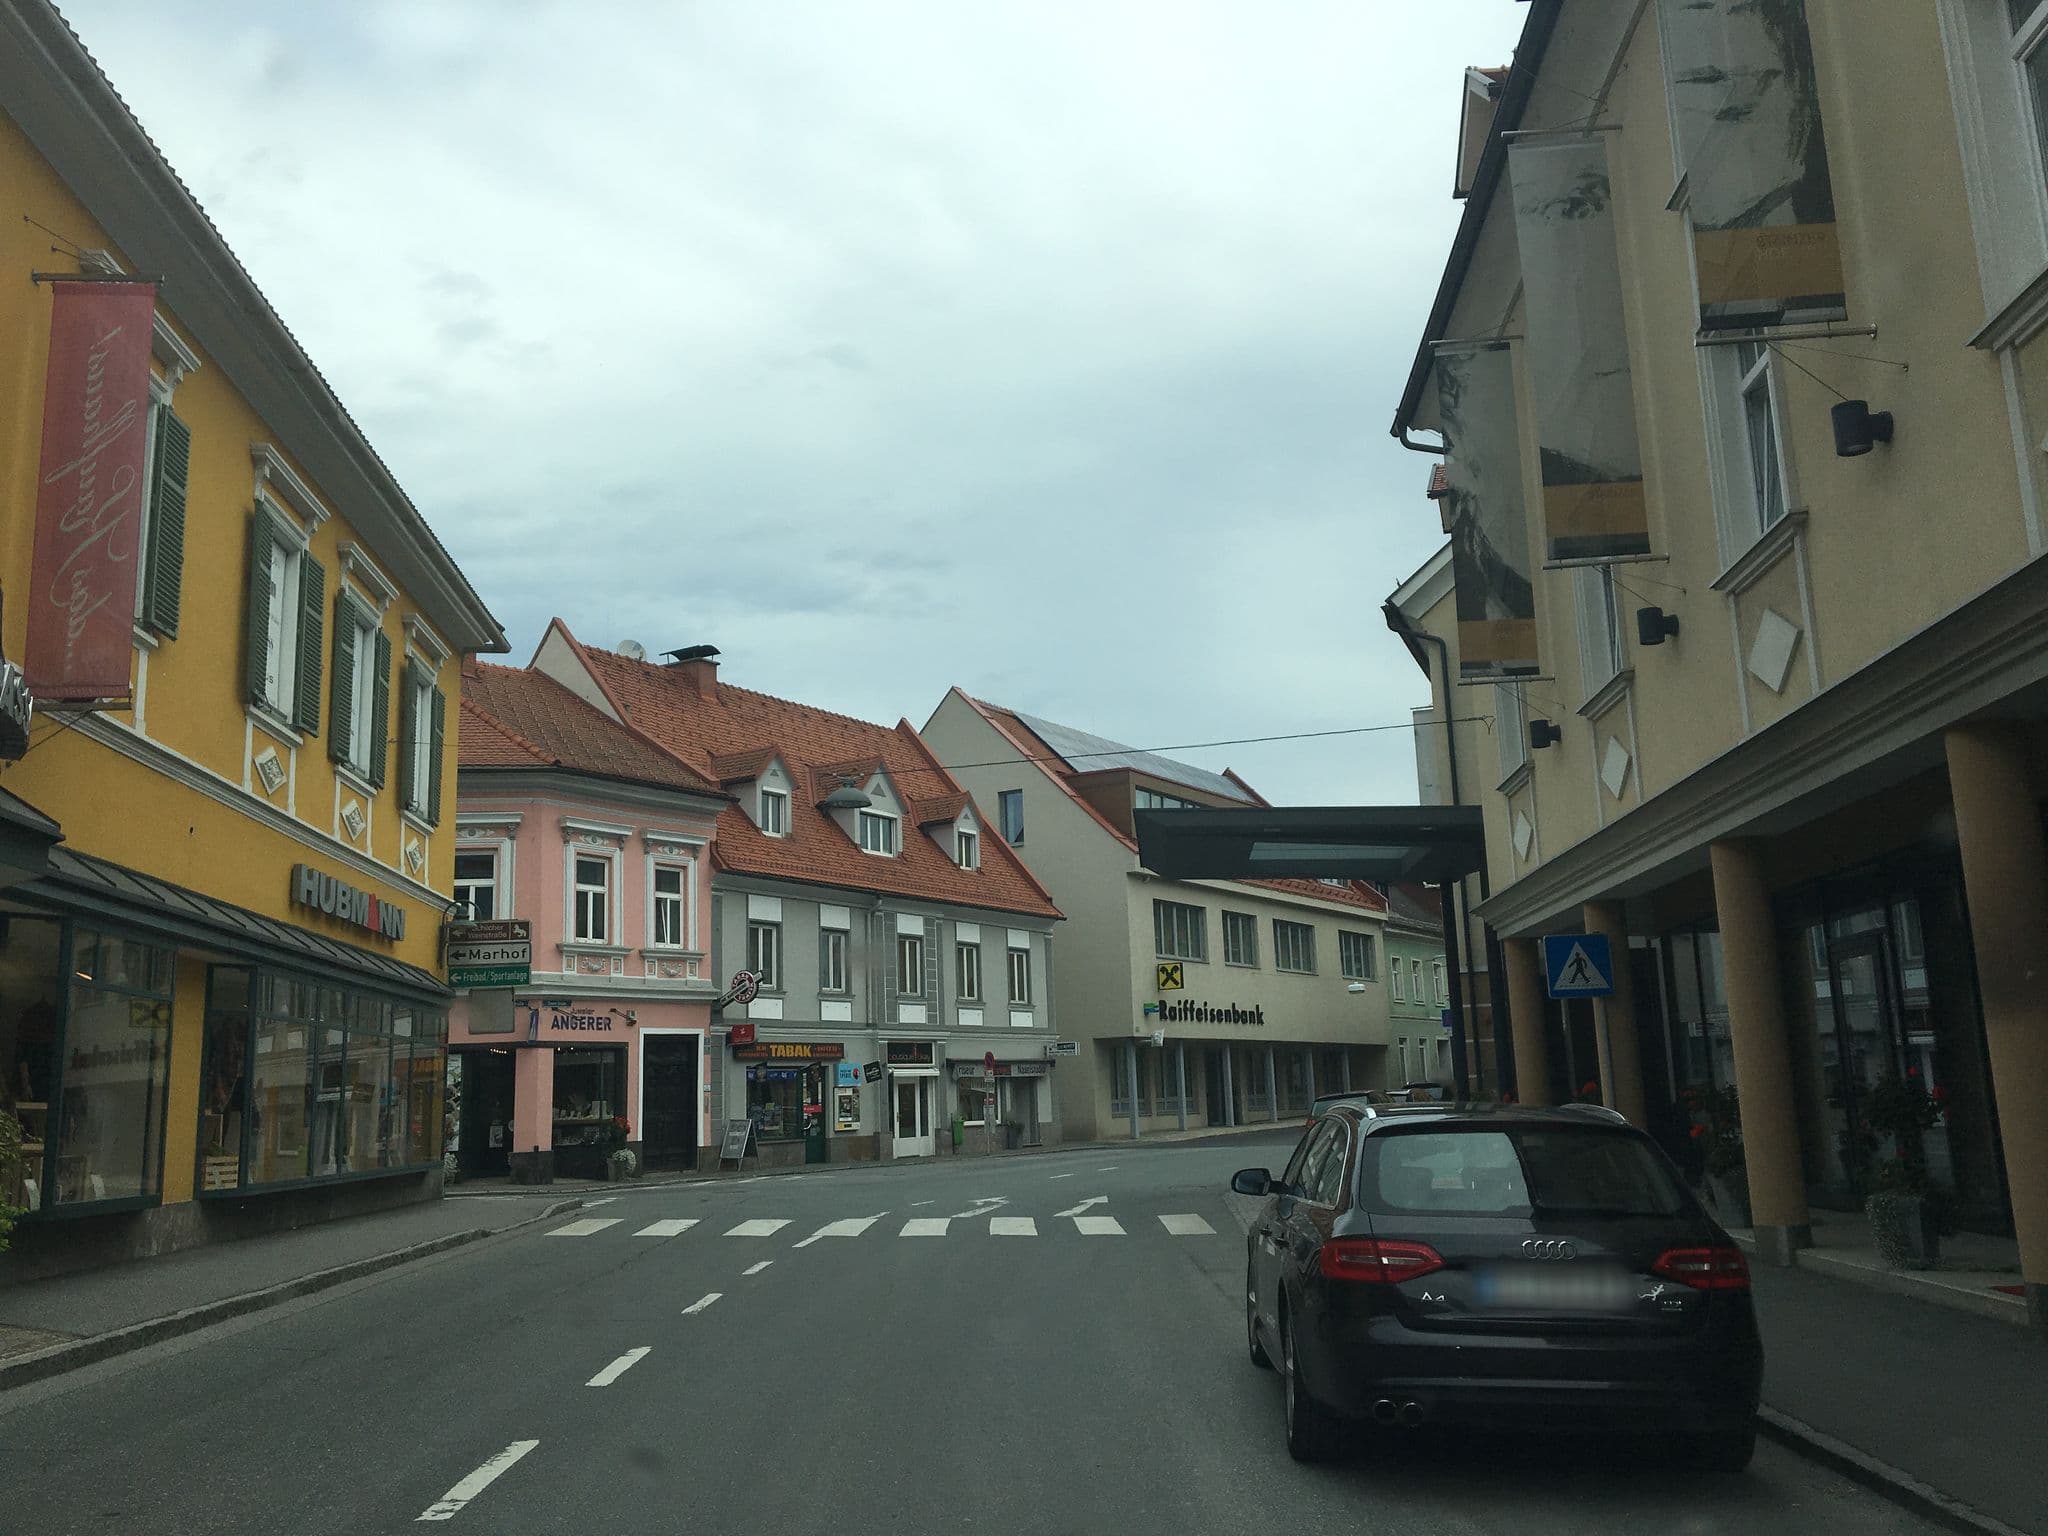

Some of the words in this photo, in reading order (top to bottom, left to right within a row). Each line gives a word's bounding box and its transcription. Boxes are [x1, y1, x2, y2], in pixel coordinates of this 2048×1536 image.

[297, 864, 406, 941] HUBMANN
[469, 947, 528, 960] Marhof
[1159, 999, 1264, 1025] Raiffeisenbank
[551, 1015, 612, 1032] ANGERER
[769, 1043, 812, 1059] TABAK
